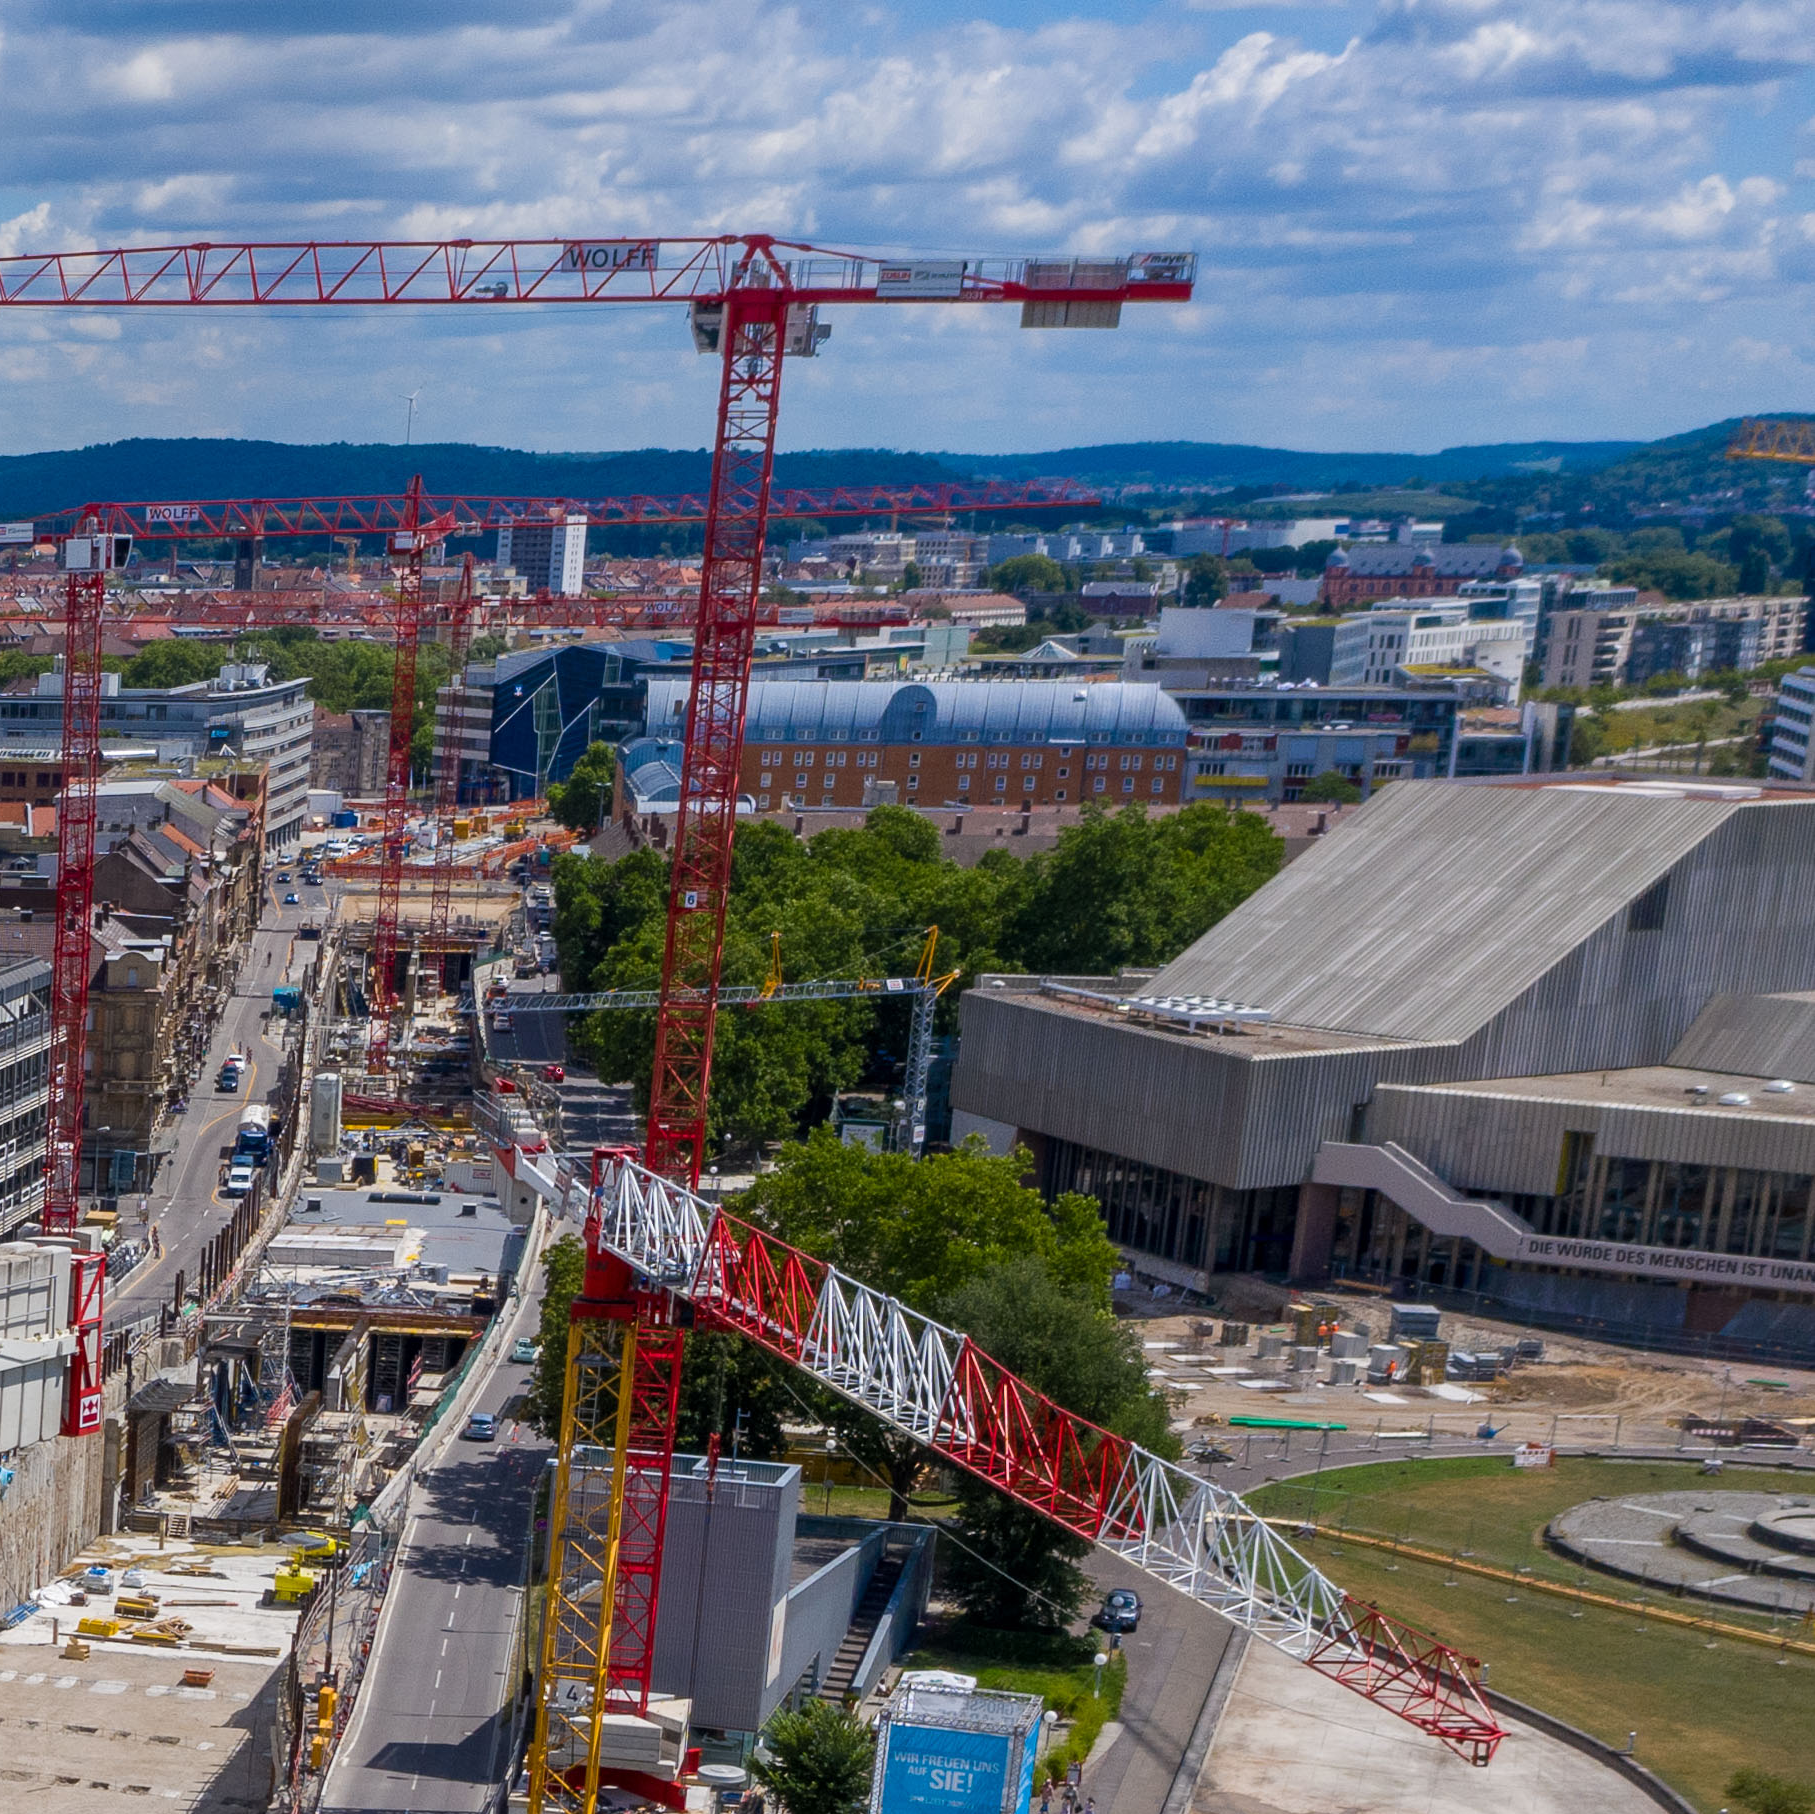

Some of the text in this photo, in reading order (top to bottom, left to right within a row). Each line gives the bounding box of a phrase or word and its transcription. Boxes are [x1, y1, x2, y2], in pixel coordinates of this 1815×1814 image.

[570, 248, 655, 268] WOLFF
[150, 508, 197, 519] WOLFF
[687, 895, 695, 905] 6
[1528, 1239, 1554, 1255] DIE
[1556, 1240, 1611, 1262] WÜRDE
[1615, 1250, 1645, 1266] DES
[1648, 1253, 1739, 1275] MENSCHEN
[1741, 1263, 1768, 1277] IST
[566, 1684, 579, 1702] 4
[894, 1751, 1001, 1774] WIR FREUEN UNS
[907, 1765, 973, 1793] AUF SIE!
